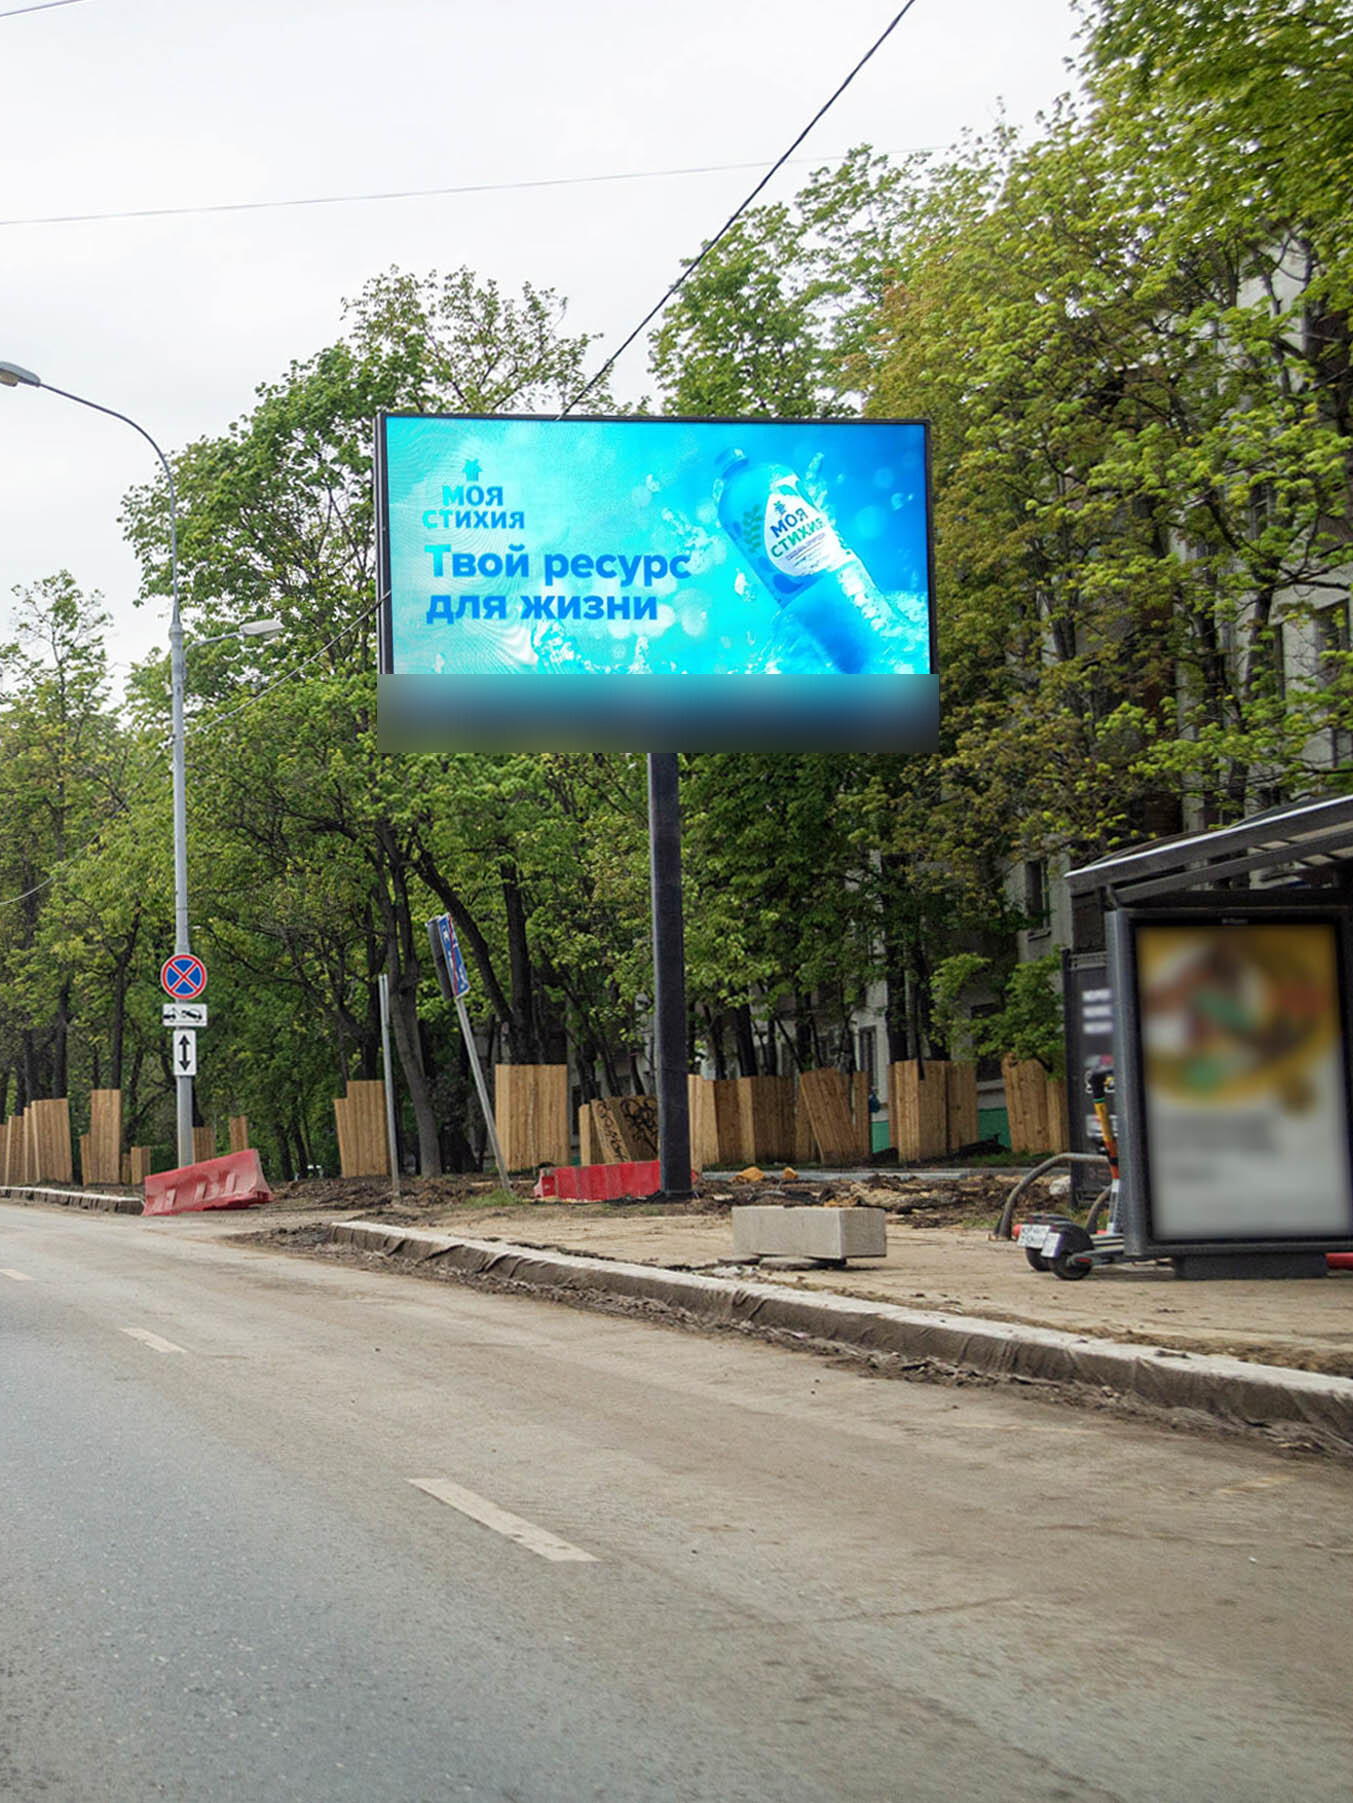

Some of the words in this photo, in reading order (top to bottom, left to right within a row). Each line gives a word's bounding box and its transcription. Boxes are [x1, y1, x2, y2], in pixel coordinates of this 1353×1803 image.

[441, 484, 504, 507] МОЯ
[422, 509, 525, 530] СТИХИЯ
[770, 507, 809, 538] МОЯ
[424, 543, 530, 578] Твой
[543, 551, 692, 588] ресурс
[426, 594, 508, 625] для
[520, 594, 658, 621] жизни
